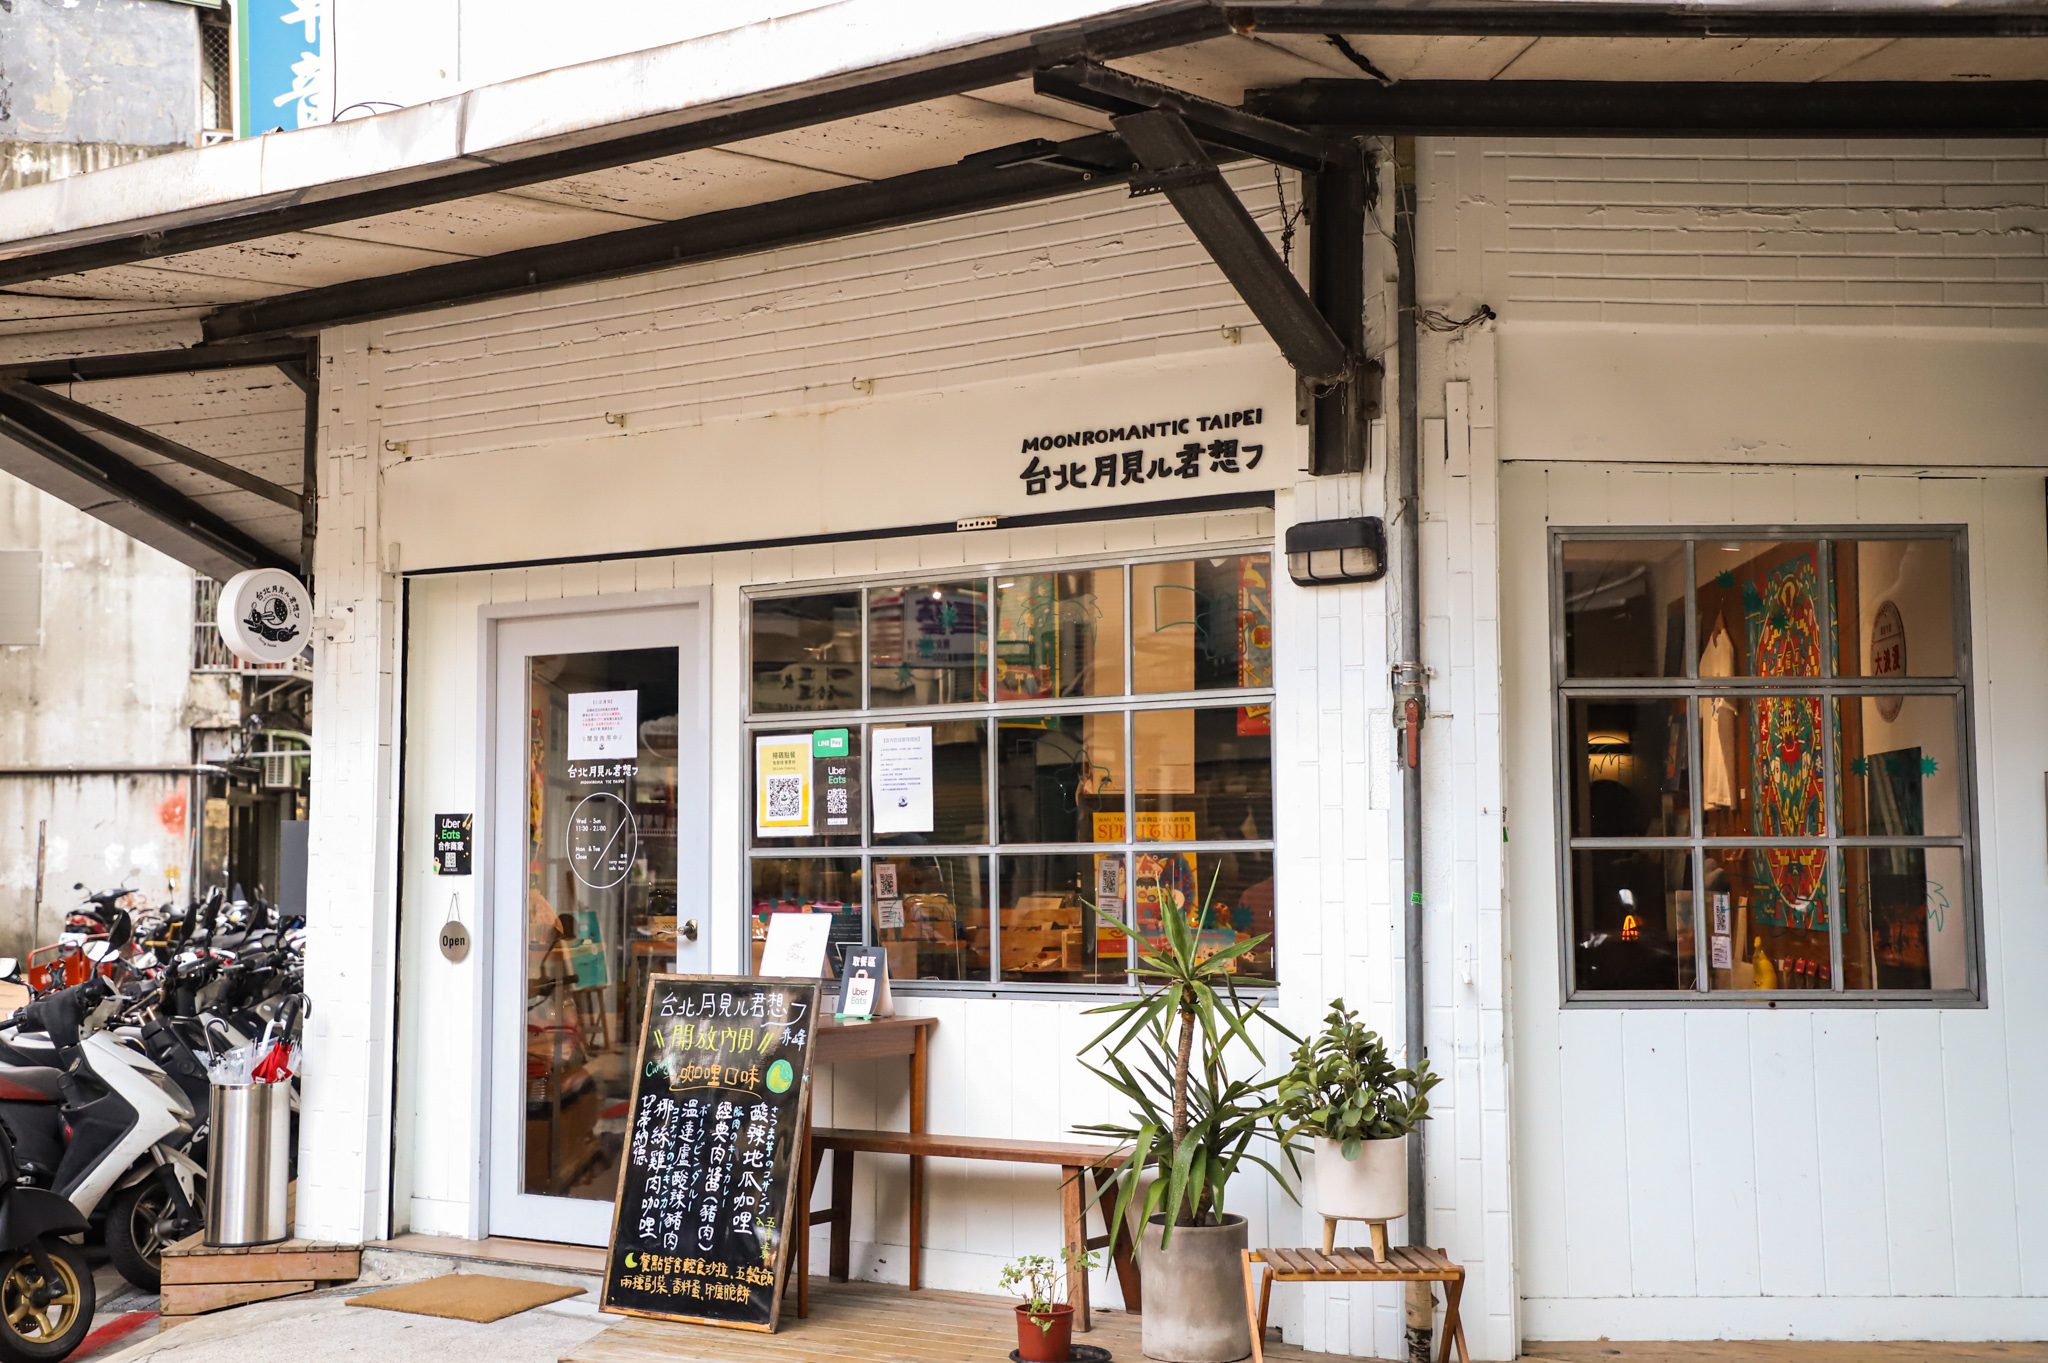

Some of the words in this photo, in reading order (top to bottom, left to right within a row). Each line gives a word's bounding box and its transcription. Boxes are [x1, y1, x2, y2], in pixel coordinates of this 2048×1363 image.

[1021, 419, 1189, 453] MOONROMANTIC
[1196, 408, 1263, 432] TAIPEI
[1020, 439, 1264, 496] 台北月見ル君想フ
[831, 738, 841, 747] Pay
[567, 764, 639, 778] 台北月見ル君想フ
[828, 766, 847, 775] Uber
[828, 776, 847, 784] Eats
[442, 818, 461, 828] Uber
[441, 830, 461, 839] Eats
[1149, 822, 1191, 840] TRIP
[438, 841, 465, 851] 合作商家
[442, 935, 465, 949] Open
[852, 988, 868, 996] Uber
[660, 991, 807, 1027] 台北月見ル君想フ
[680, 1061, 761, 1090] 咖哩口味
[639, 1098, 674, 1239] 椰絲雞肉咖哩
[732, 1101, 769, 1235] 酸辣地瓜咖哩
